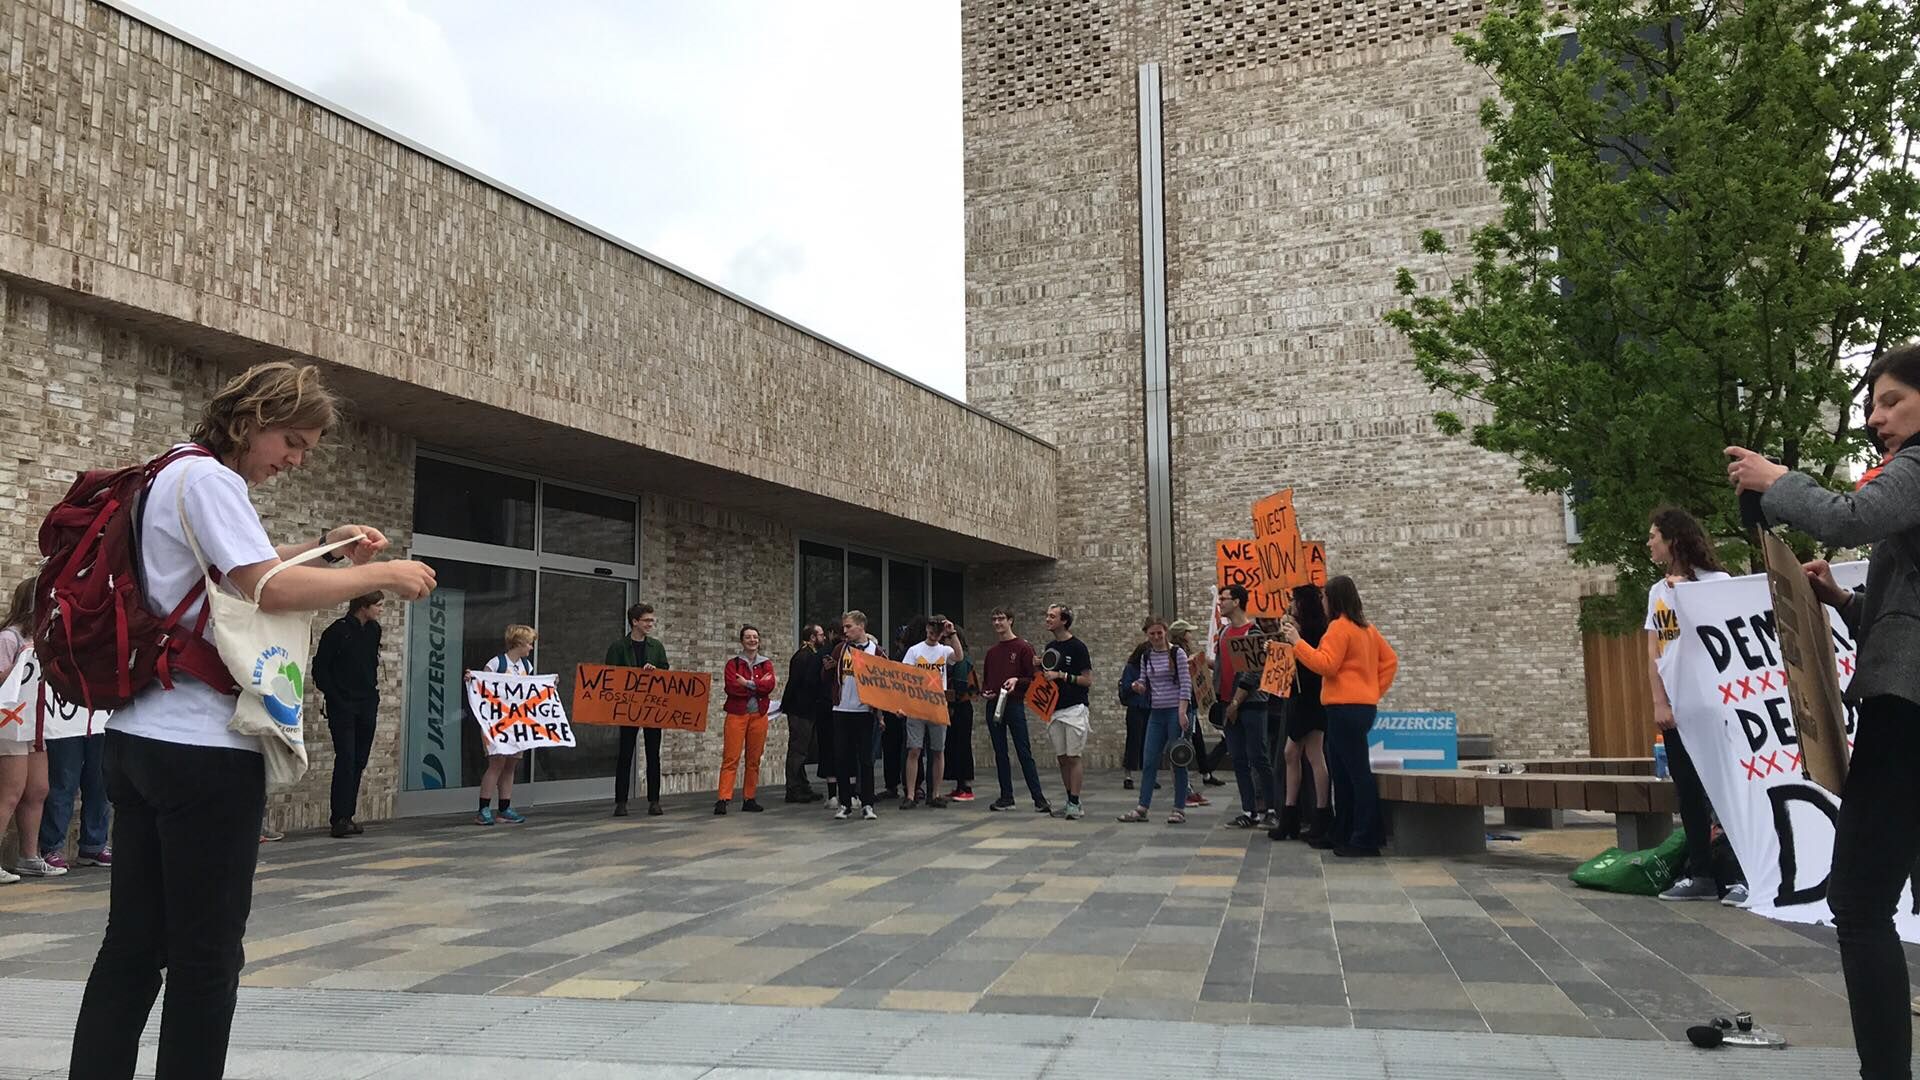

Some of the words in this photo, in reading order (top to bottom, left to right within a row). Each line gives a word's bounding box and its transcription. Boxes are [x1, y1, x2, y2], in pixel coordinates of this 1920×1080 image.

[1254, 506, 1286, 539] DIVEST
[1222, 543, 1253, 560] WE
[1258, 535, 1296, 579] NOW
[1224, 565, 1260, 588] FOSS
[1696, 610, 1779, 674] DEM
[1245, 650, 1266, 670] NO
[427, 594, 446, 750] JAZZERCISE
[579, 665, 615, 691] WE
[624, 671, 706, 697] DEMAND
[580, 691, 592, 700] A
[600, 690, 638, 704] FOSSIL
[643, 694, 669, 708] FREE
[480, 701, 561, 721] CHANGE
[613, 701, 702, 727] FUTURE!
[488, 722, 509, 743] IS
[513, 722, 571, 742] HERE
[1373, 717, 1454, 730] JAZZERCISE
